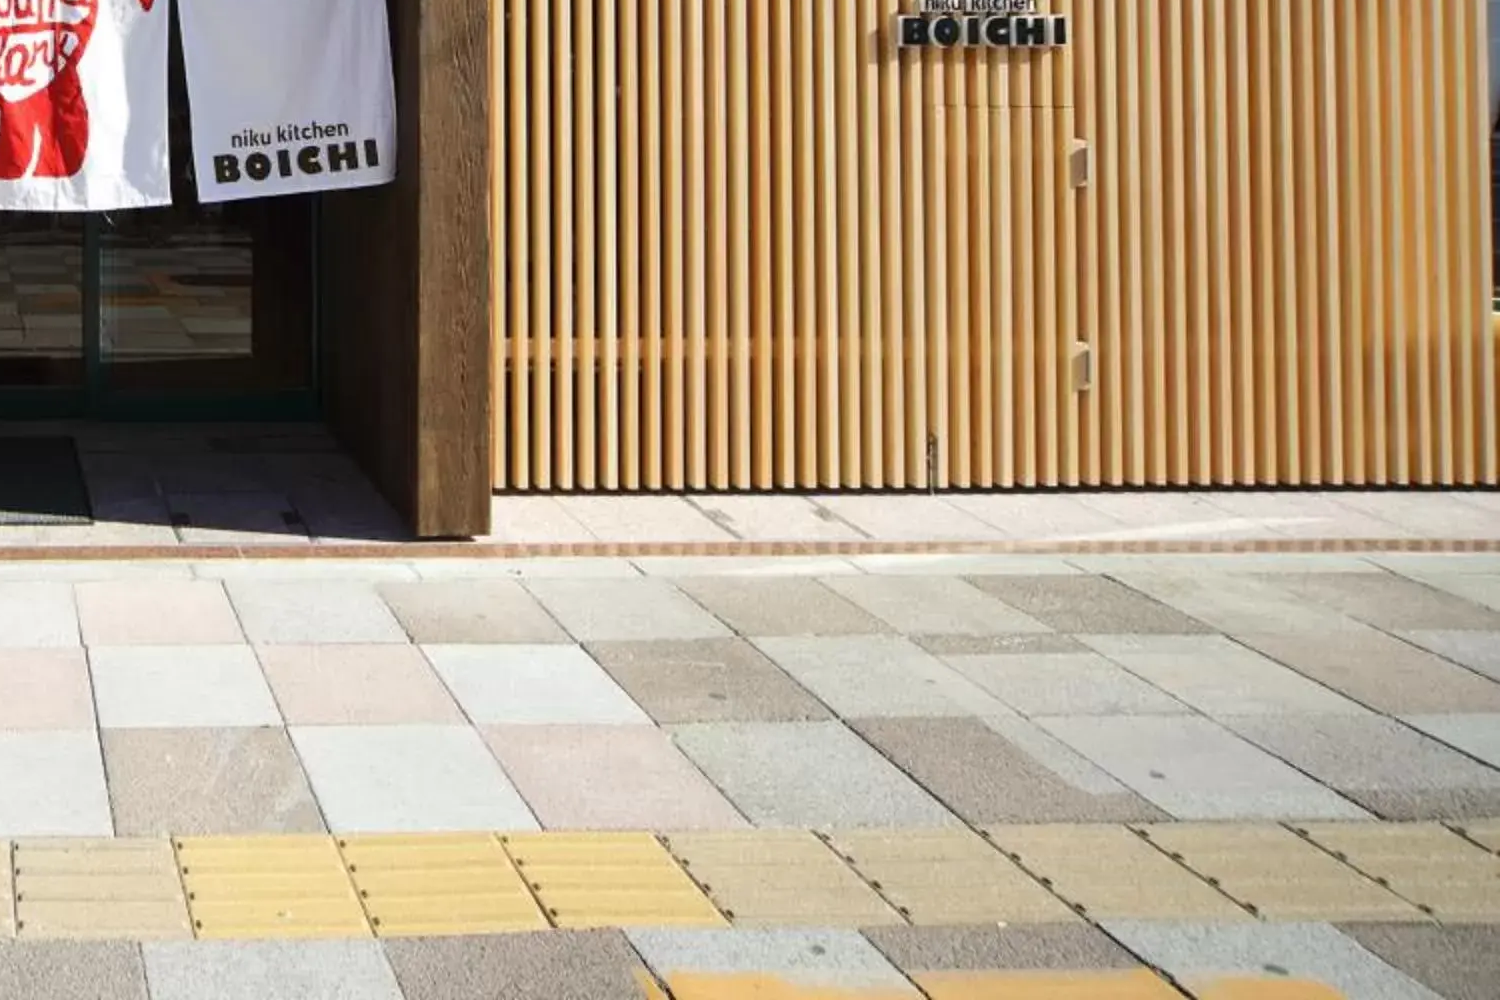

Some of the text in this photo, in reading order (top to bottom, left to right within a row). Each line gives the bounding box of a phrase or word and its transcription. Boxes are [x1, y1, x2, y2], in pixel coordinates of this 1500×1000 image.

[899, 14, 1067, 48] BOICHI
[231, 120, 349, 148] niku kitchen
[213, 138, 379, 184] BOICHI
